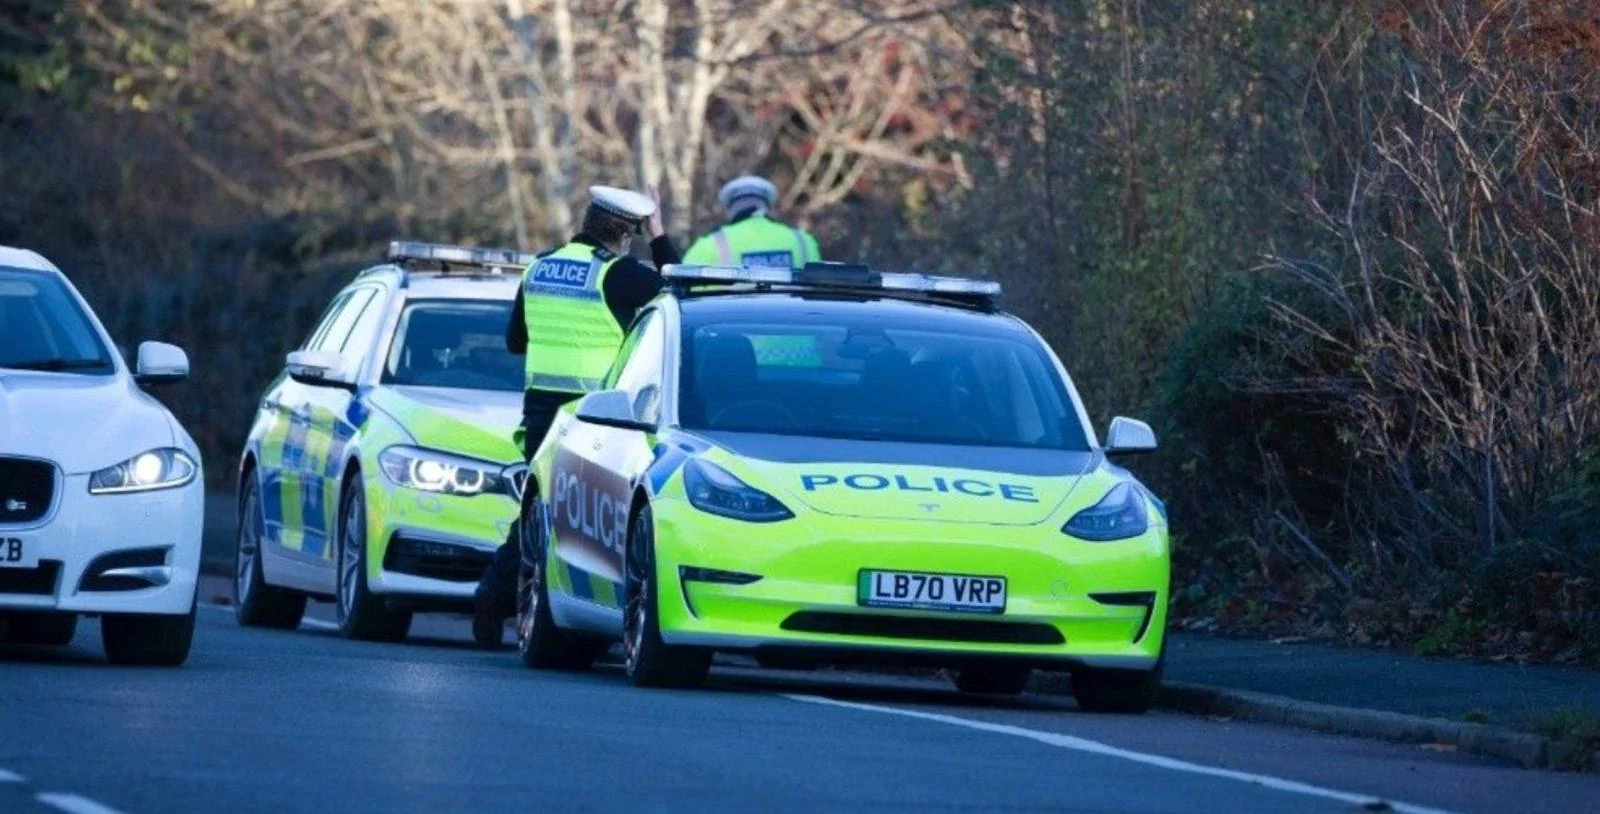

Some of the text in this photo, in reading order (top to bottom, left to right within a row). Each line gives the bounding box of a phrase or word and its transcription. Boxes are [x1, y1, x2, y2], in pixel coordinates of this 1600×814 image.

[535, 262, 588, 282] POLICE
[801, 474, 1039, 503] POLICE
[554, 467, 626, 555] POLICE
[876, 573, 1003, 603] LB70 VRP
